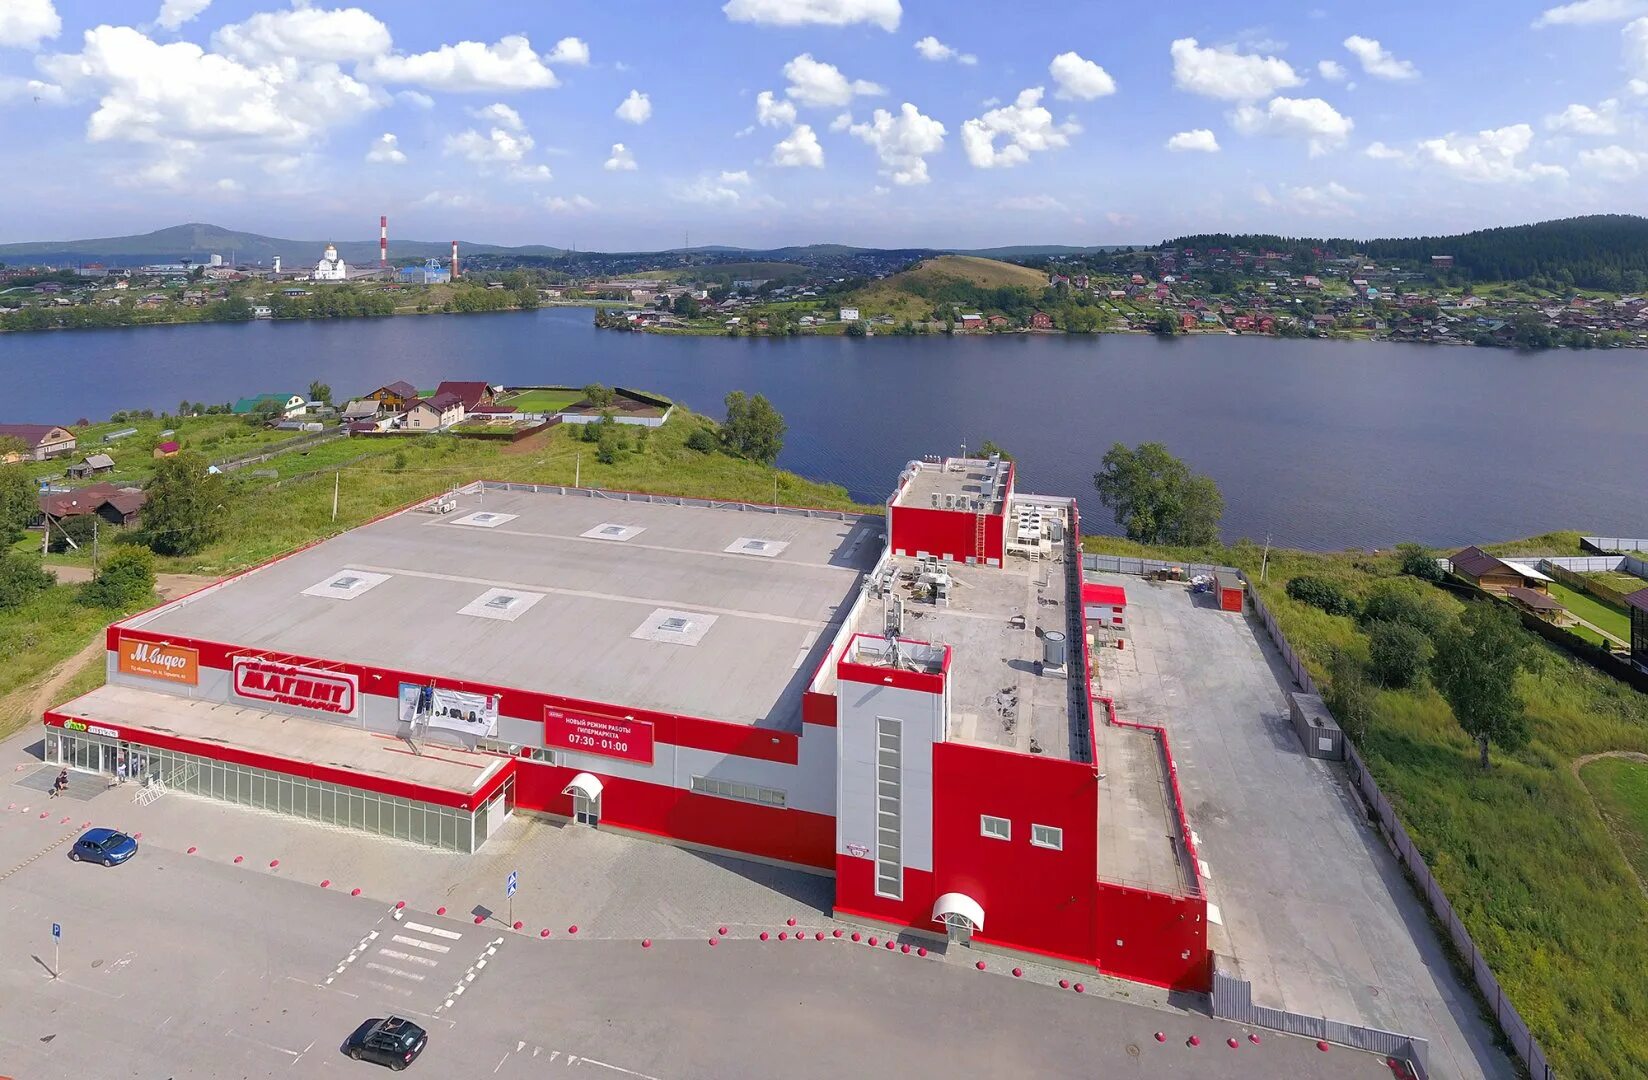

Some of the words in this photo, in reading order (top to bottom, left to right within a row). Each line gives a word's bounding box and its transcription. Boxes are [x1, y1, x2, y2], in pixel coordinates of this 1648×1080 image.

[242, 671, 346, 703] МАГНИТ
[566, 718, 586, 726] НОВЫЙ
[587, 721, 608, 730] РЕЖИМ
[608, 725, 631, 734] РАБОТЫ
[577, 728, 619, 739] ГИПЕРМАРКЕТА
[568, 734, 594, 746] 07:30
[601, 740, 628, 752] 01:00
